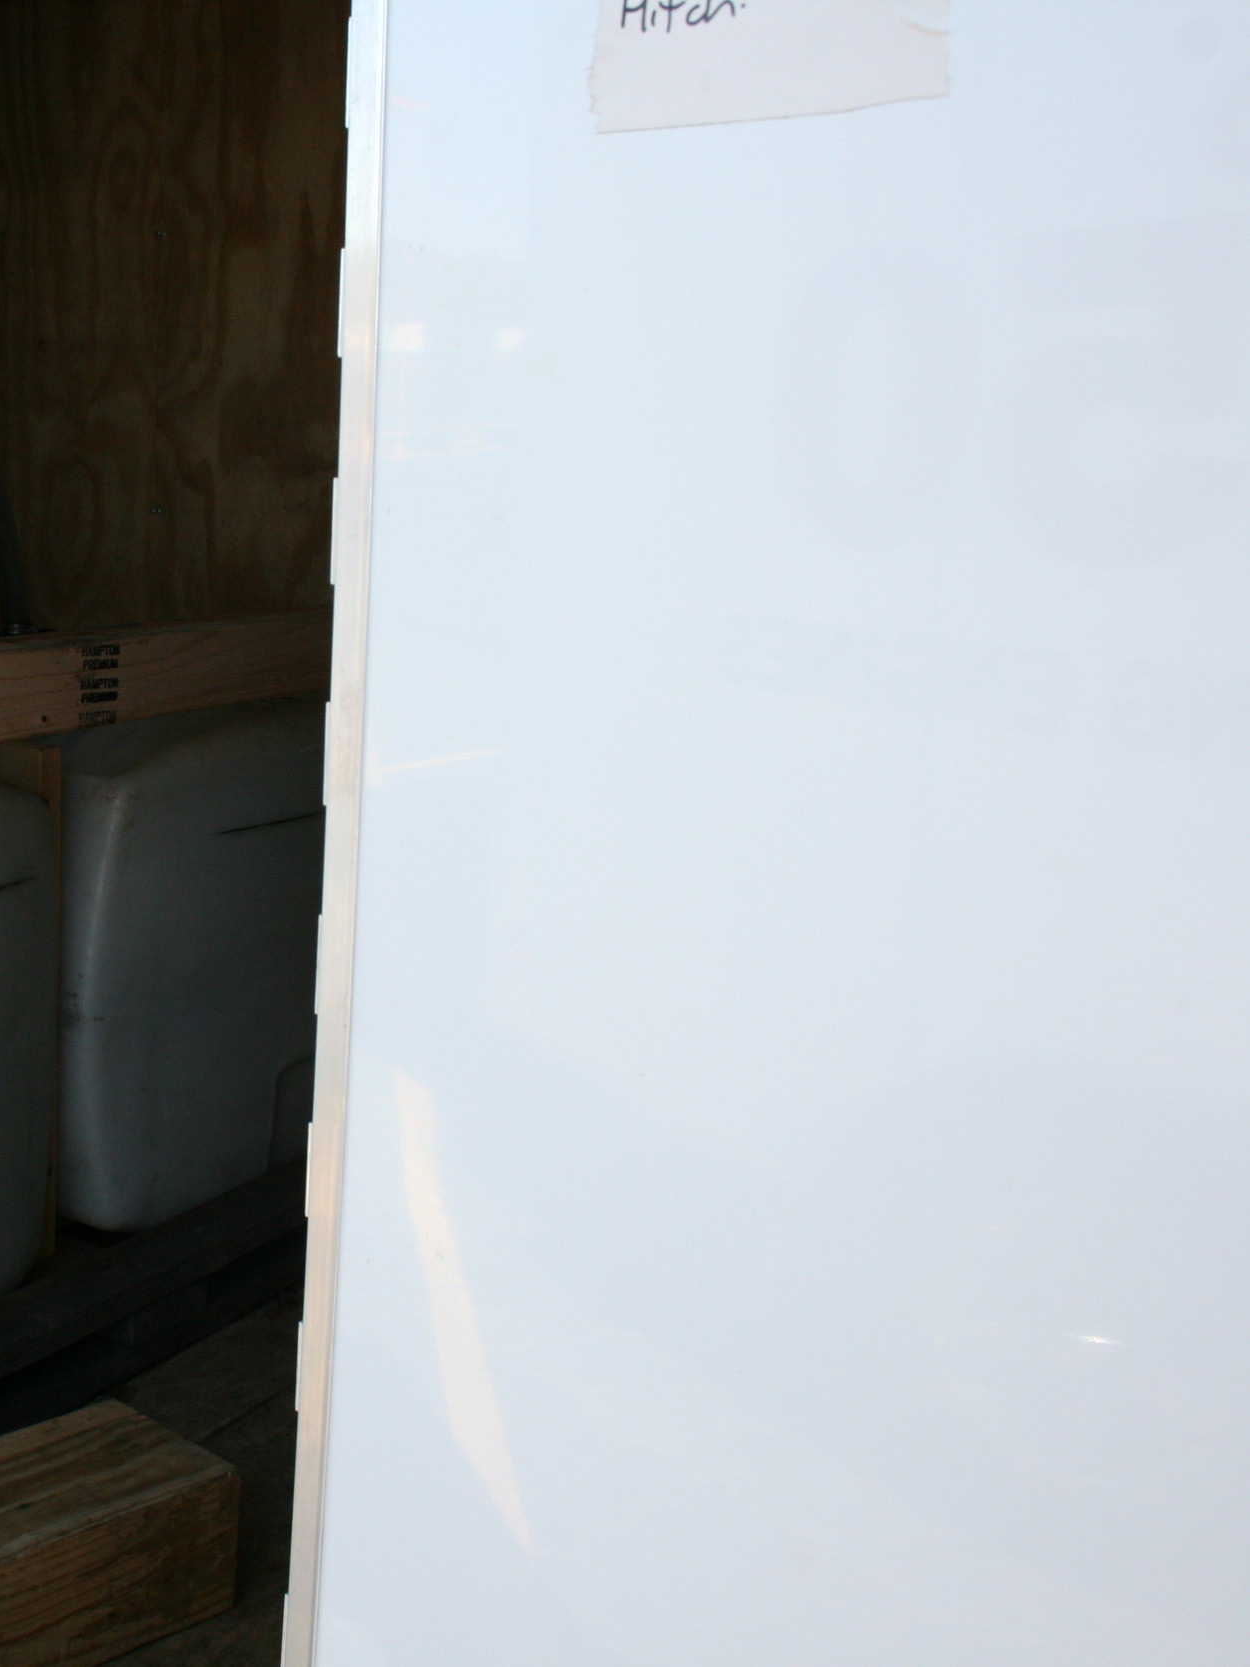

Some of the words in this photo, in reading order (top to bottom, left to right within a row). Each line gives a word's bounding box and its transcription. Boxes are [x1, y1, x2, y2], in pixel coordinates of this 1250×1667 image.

[82, 644, 120, 657] HAMPTON
[83, 658, 118, 670] PREMIUM
[81, 678, 119, 690] HAMPTON
